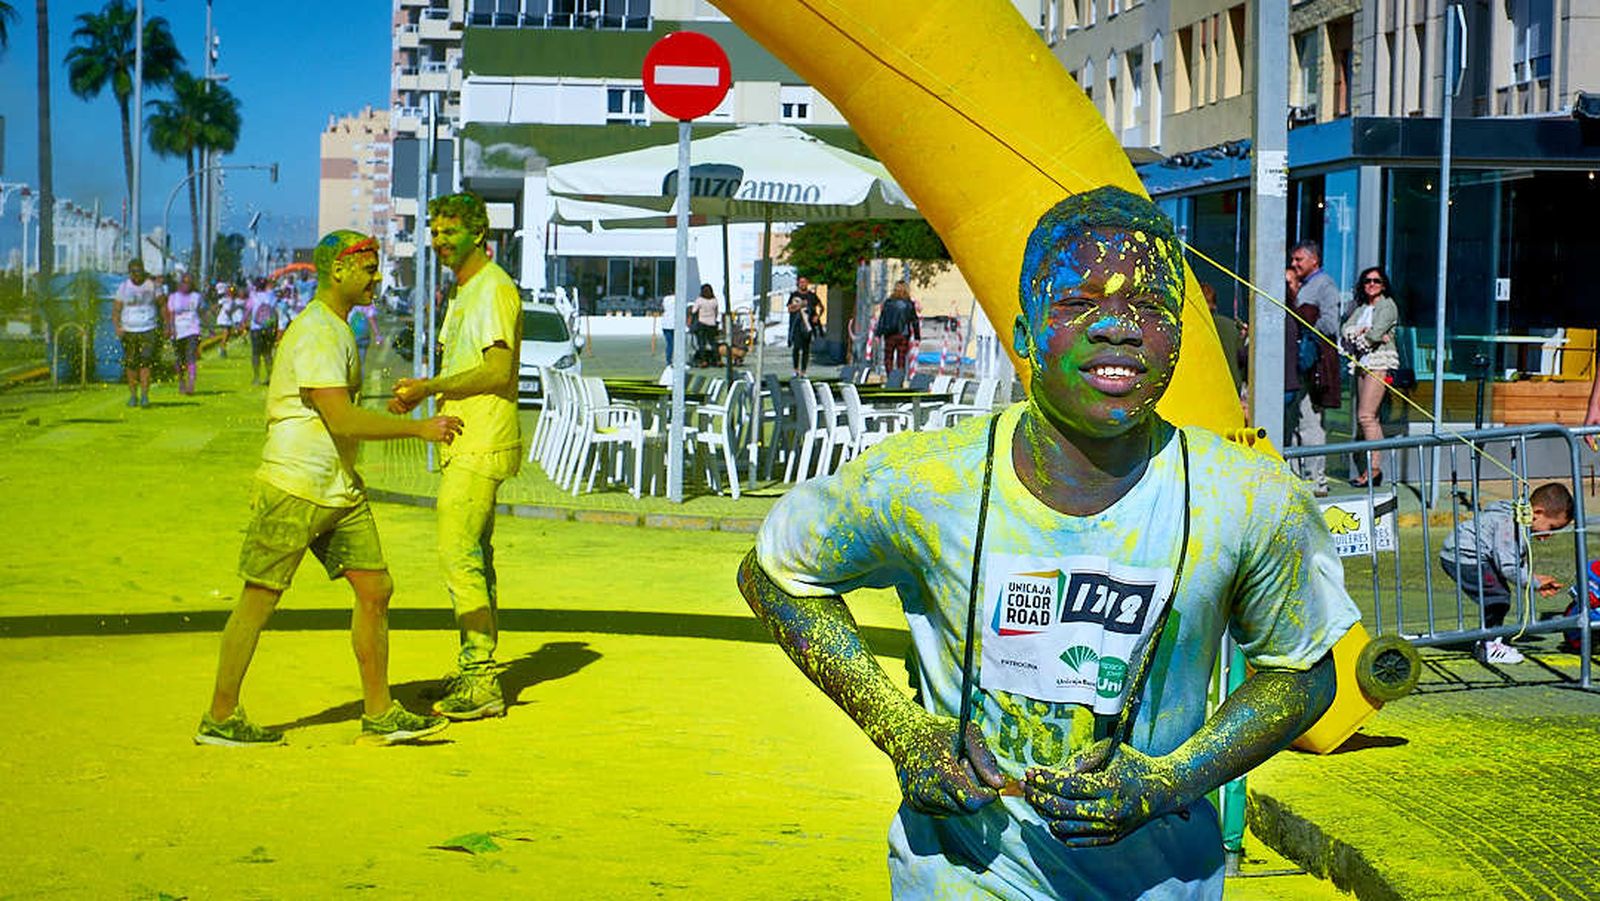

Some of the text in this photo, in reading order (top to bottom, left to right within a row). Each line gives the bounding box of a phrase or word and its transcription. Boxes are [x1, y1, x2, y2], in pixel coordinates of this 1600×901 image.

[1008, 582, 1052, 595] UNICAJA
[1008, 594, 1051, 610] COLOR
[1072, 583, 1143, 624] 1712
[1007, 608, 1050, 626] ROAD
[1097, 676, 1123, 693] Uni
